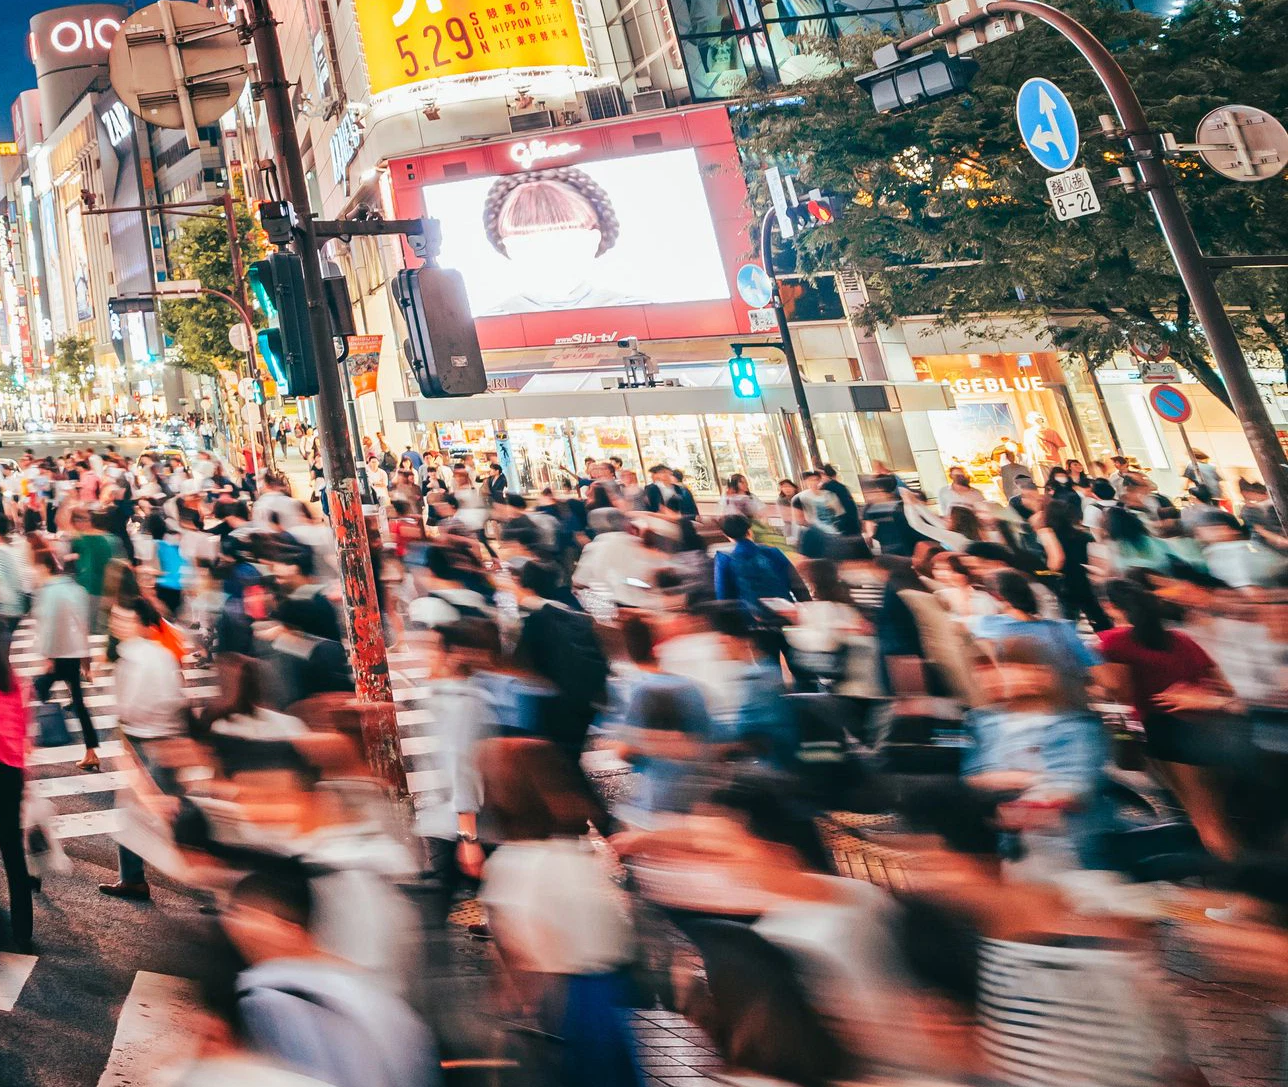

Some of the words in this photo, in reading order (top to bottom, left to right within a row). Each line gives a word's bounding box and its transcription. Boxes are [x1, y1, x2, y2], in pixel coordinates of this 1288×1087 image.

[469, 12, 491, 54] SUN
[492, 17, 532, 34] NIPPON
[395, 17, 474, 78] 5.29
[499, 38, 512, 50] AT
